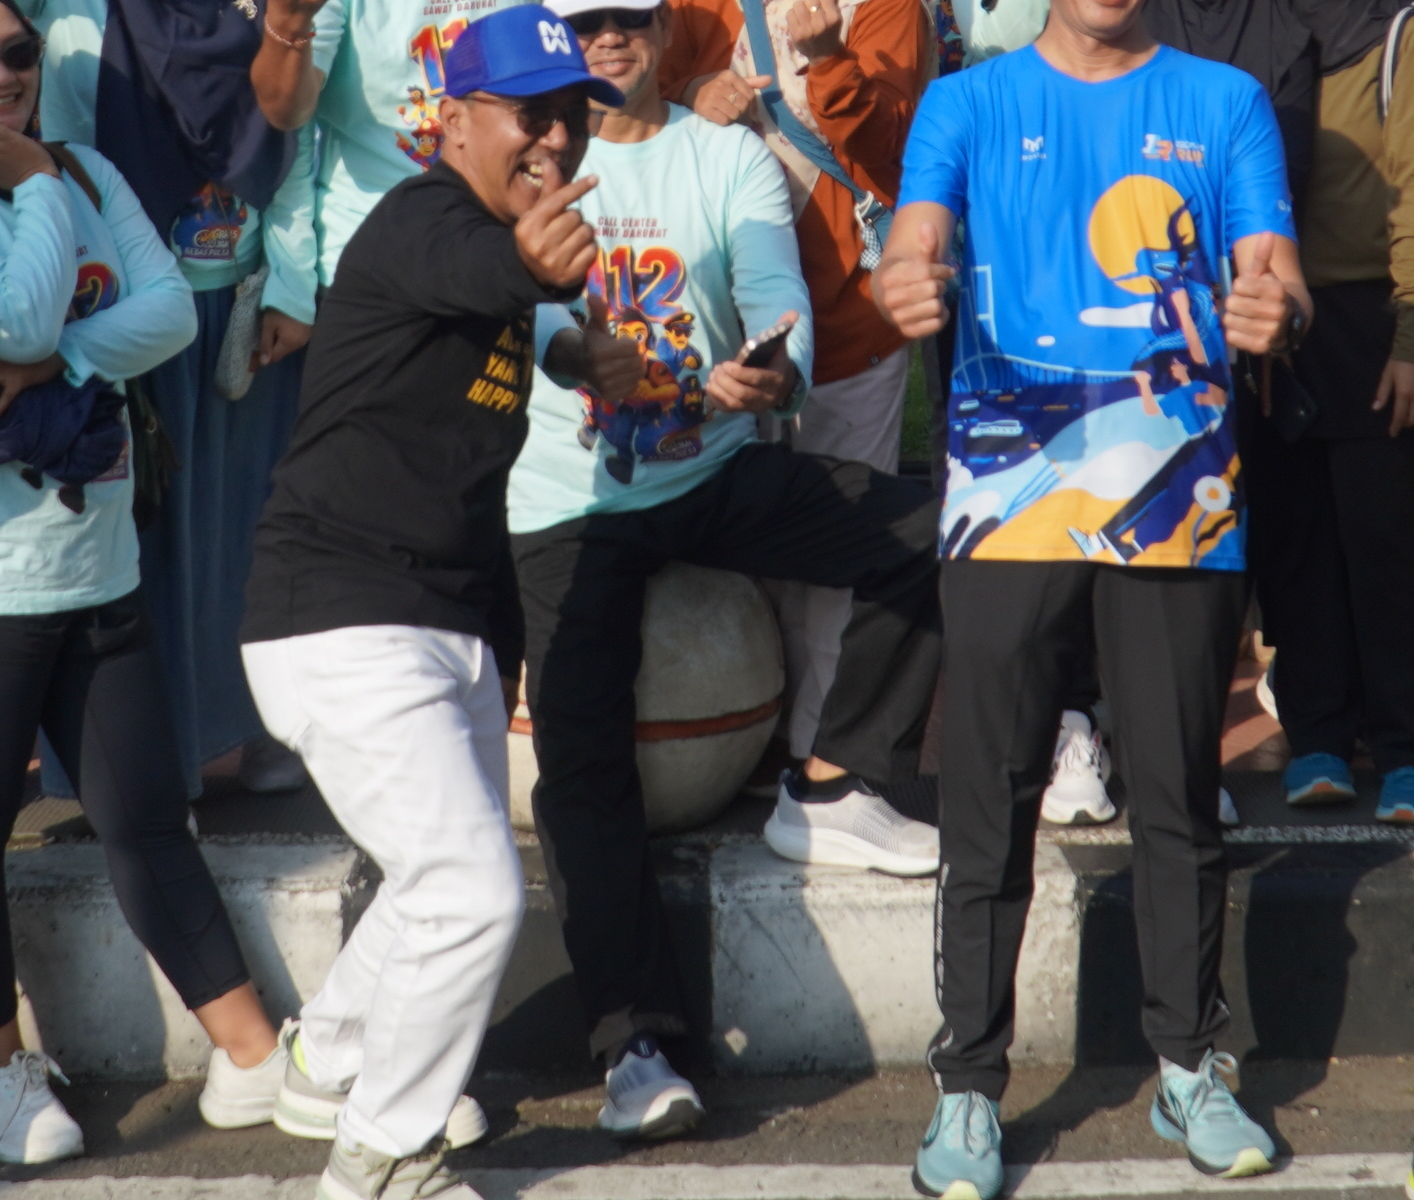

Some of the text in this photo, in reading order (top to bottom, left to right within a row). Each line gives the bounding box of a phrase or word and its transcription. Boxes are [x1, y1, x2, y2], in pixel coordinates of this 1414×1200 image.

[423, 0, 497, 16] GAWAT DARURAT
[598, 216, 658, 228] CALL CENTER
[622, 228, 668, 238] DARURAT
